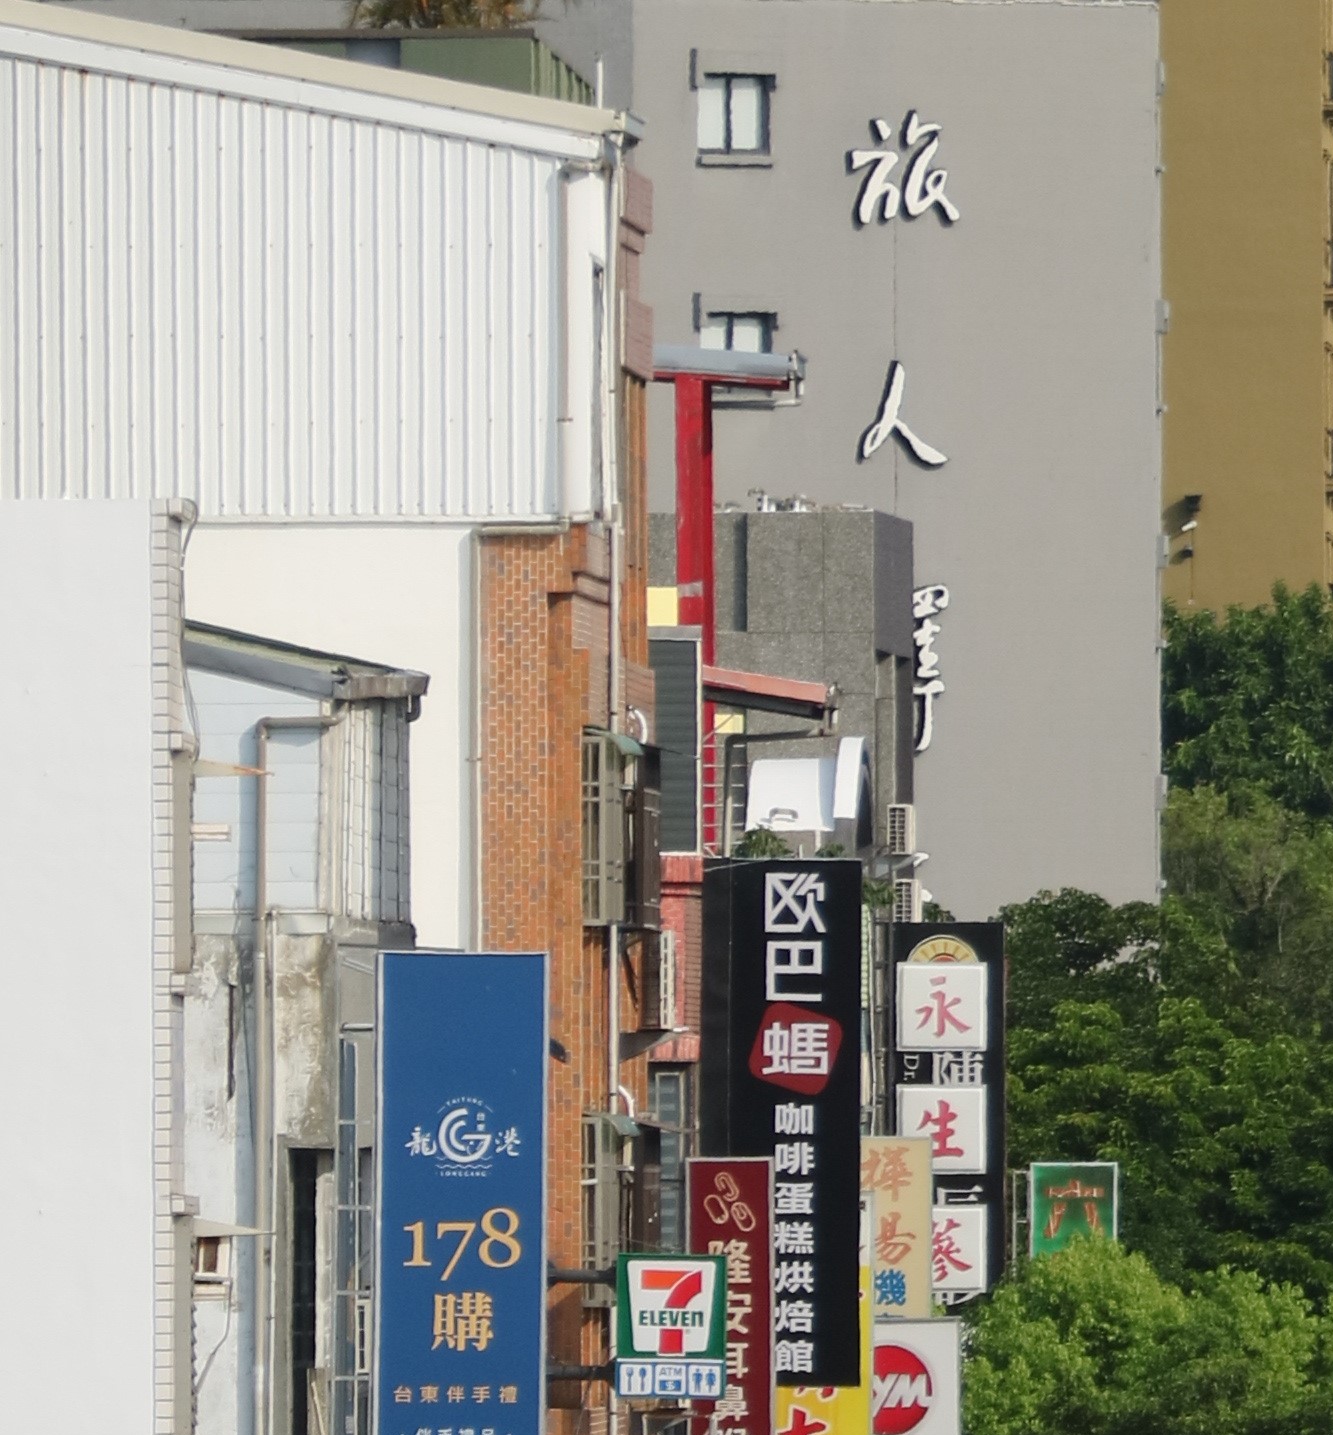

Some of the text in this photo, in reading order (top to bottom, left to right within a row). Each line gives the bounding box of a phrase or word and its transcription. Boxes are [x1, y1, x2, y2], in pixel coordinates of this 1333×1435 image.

[403, 1208, 522, 1281] 178
[774, 1104, 814, 1374] 咖啡蛋糕烘焙館
[431, 1291, 493, 1351] 購
[393, 1384, 518, 1404] 台東伴手禮
[658, 1366, 682, 1377] ATM
[872, 1373, 933, 1418] YM
